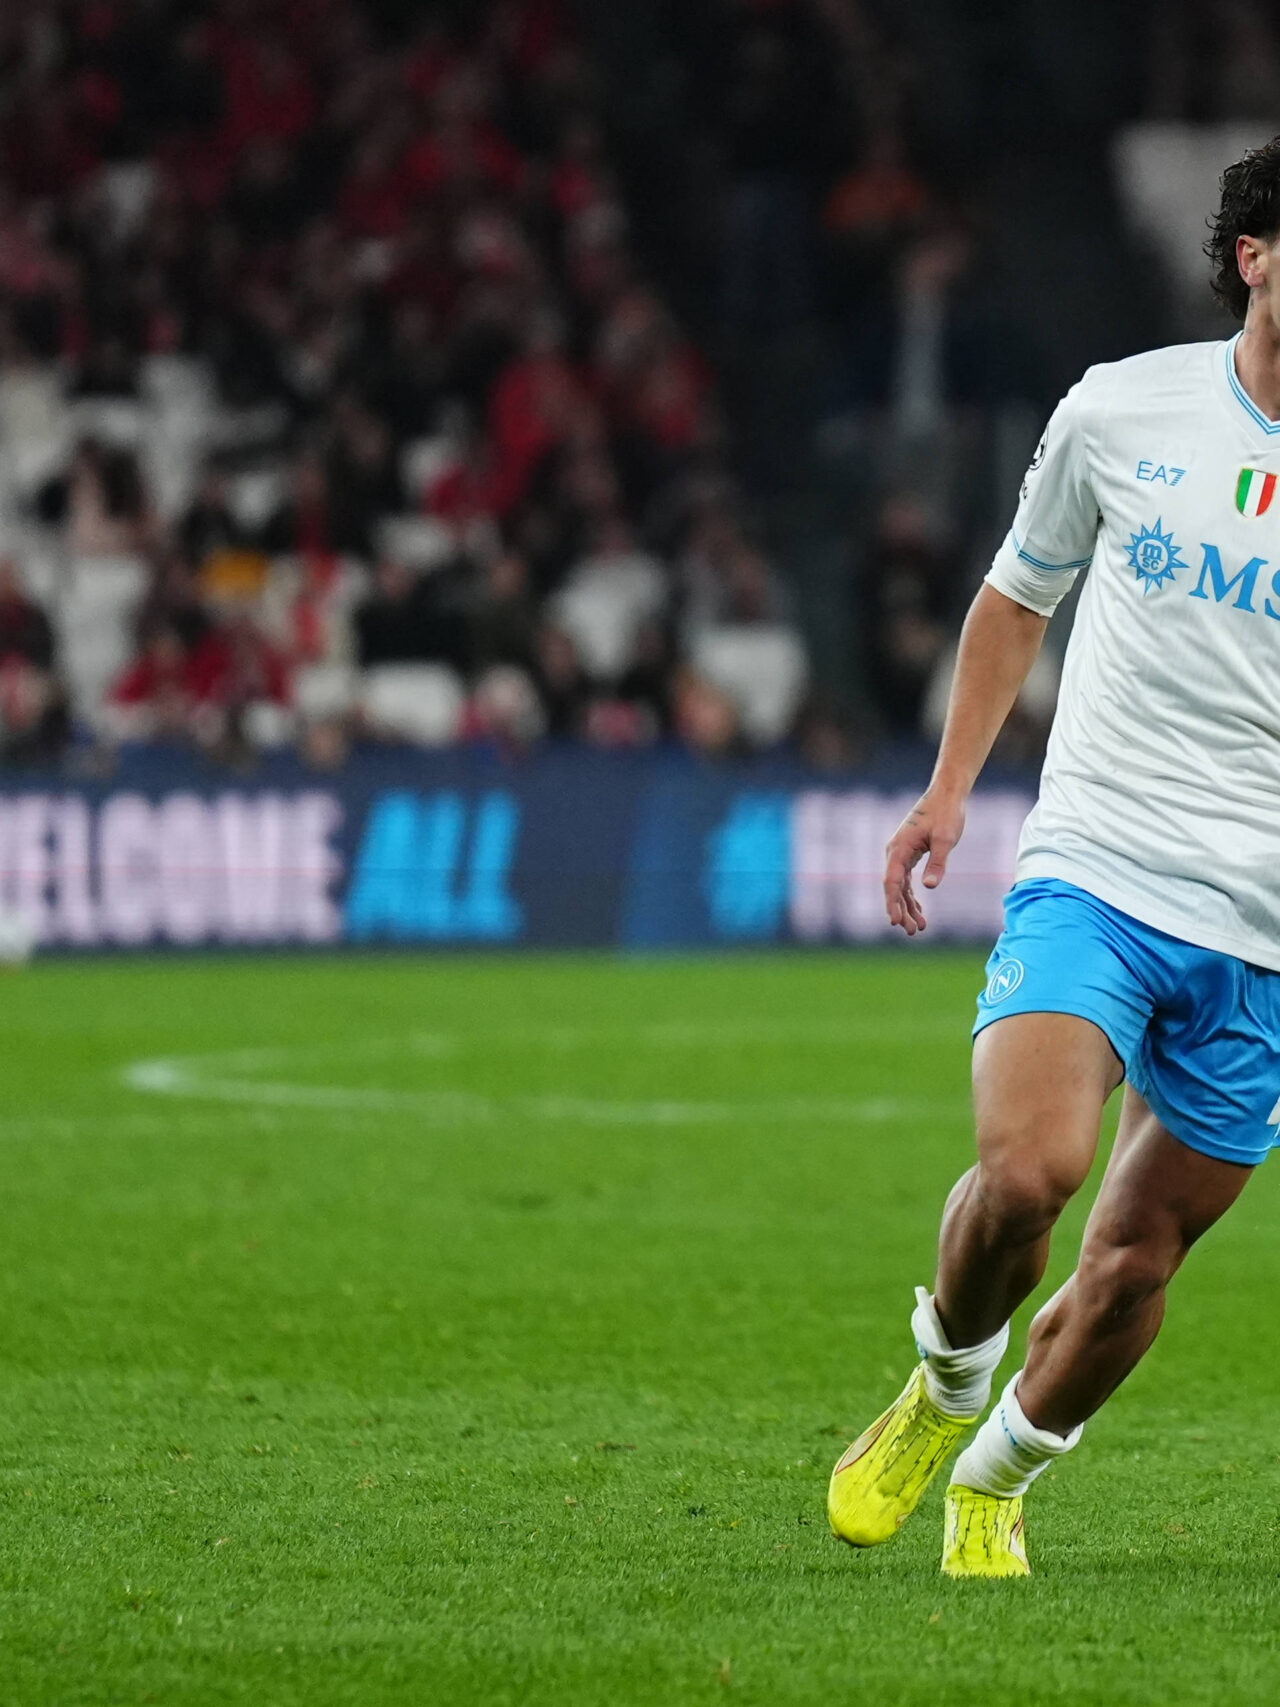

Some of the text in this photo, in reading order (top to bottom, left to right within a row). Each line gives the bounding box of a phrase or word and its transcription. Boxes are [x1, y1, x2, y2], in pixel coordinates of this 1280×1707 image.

[1136, 460, 1187, 487] EA7
[0, 790, 342, 942] ELCOME
[343, 788, 530, 942] ALL
